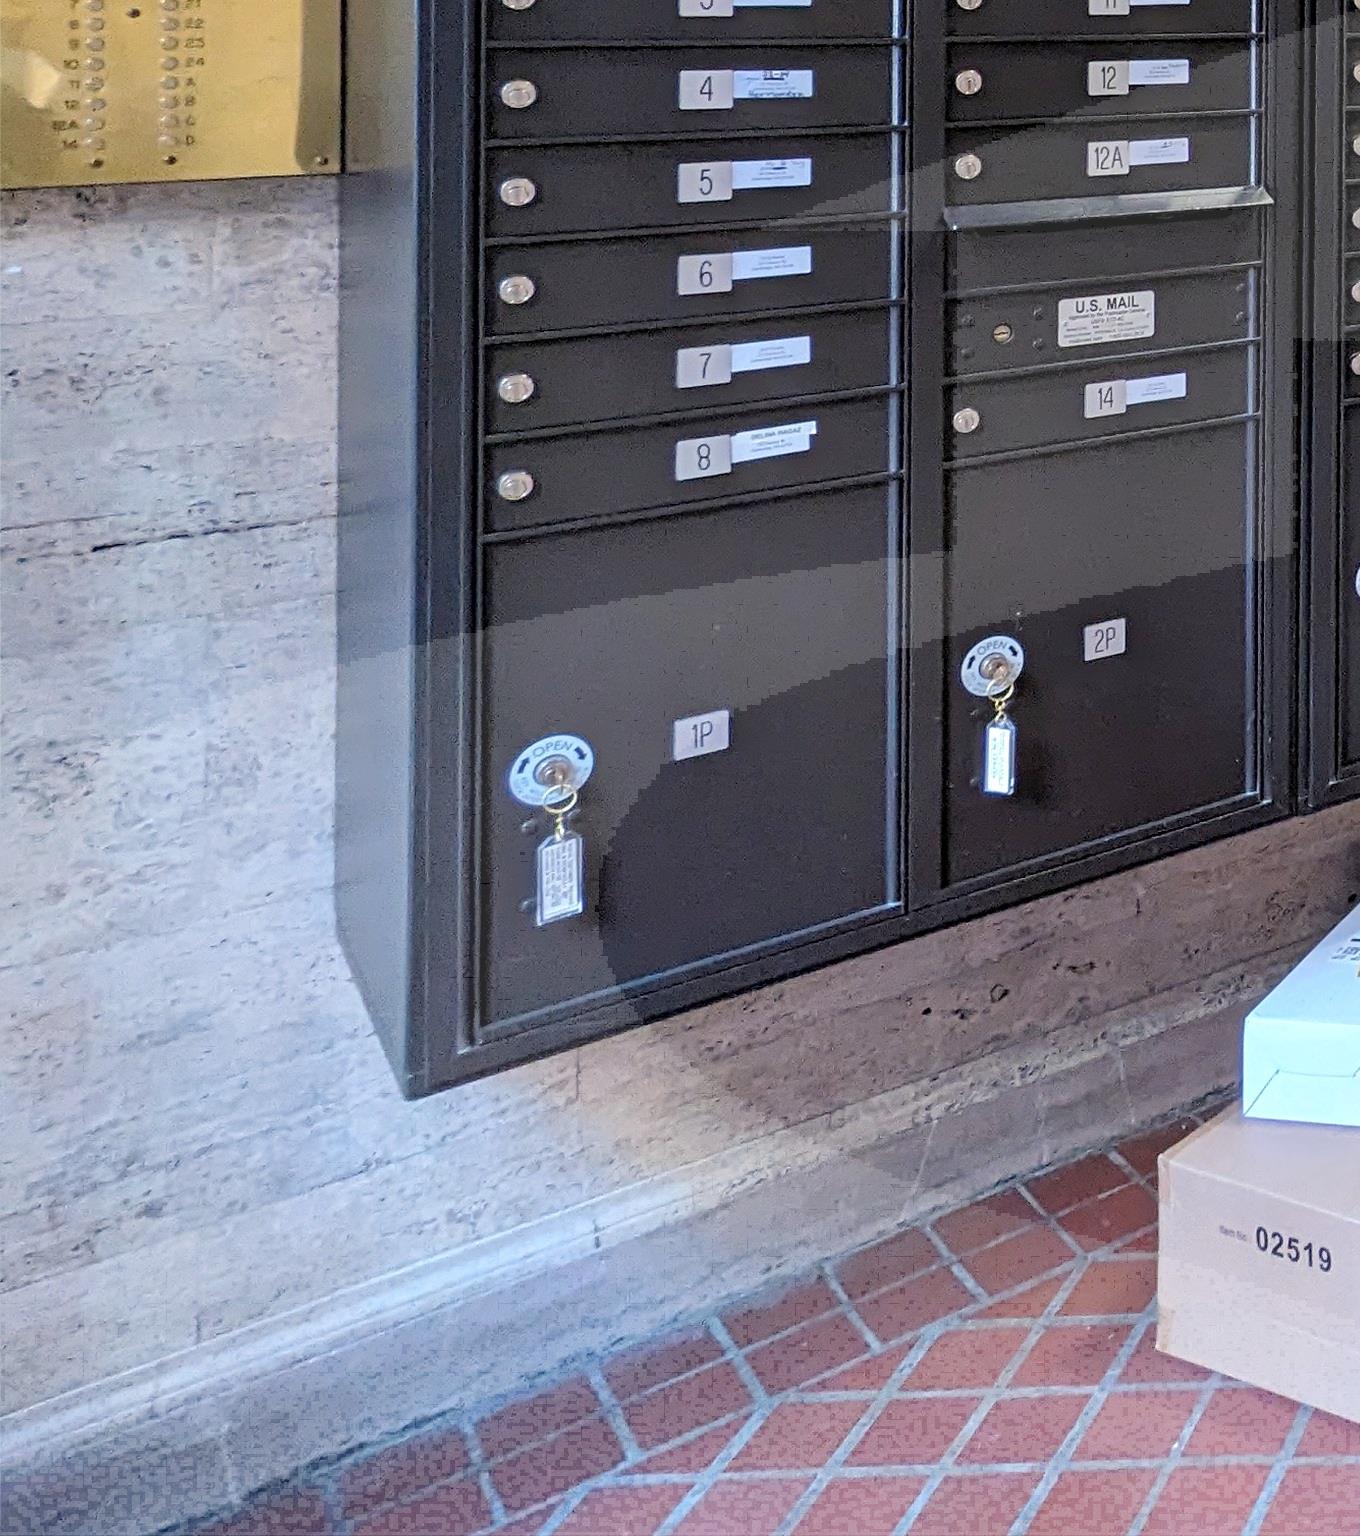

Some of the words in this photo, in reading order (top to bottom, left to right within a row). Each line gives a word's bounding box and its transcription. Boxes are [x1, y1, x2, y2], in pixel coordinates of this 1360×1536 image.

[63, 58, 80, 70] 10
[700, 75, 713, 102] 4
[1101, 65, 1117, 90] 12
[186, 135, 195, 146] D
[1094, 145, 1124, 171] 12A
[700, 168, 713, 196] 5
[699, 260, 713, 288] 6
[1075, 299, 1103, 314] U.S.
[1106, 295, 1140, 311] MAIL
[699, 352, 712, 379] 7
[1097, 386, 1114, 411] 14
[697, 443, 711, 471] 8
[976, 639, 1008, 657] OPEN
[1094, 626, 1116, 653] 2P
[691, 719, 714, 749] 1P
[532, 738, 573, 760] OPEN
[1256, 1226, 1332, 1272] 02519
